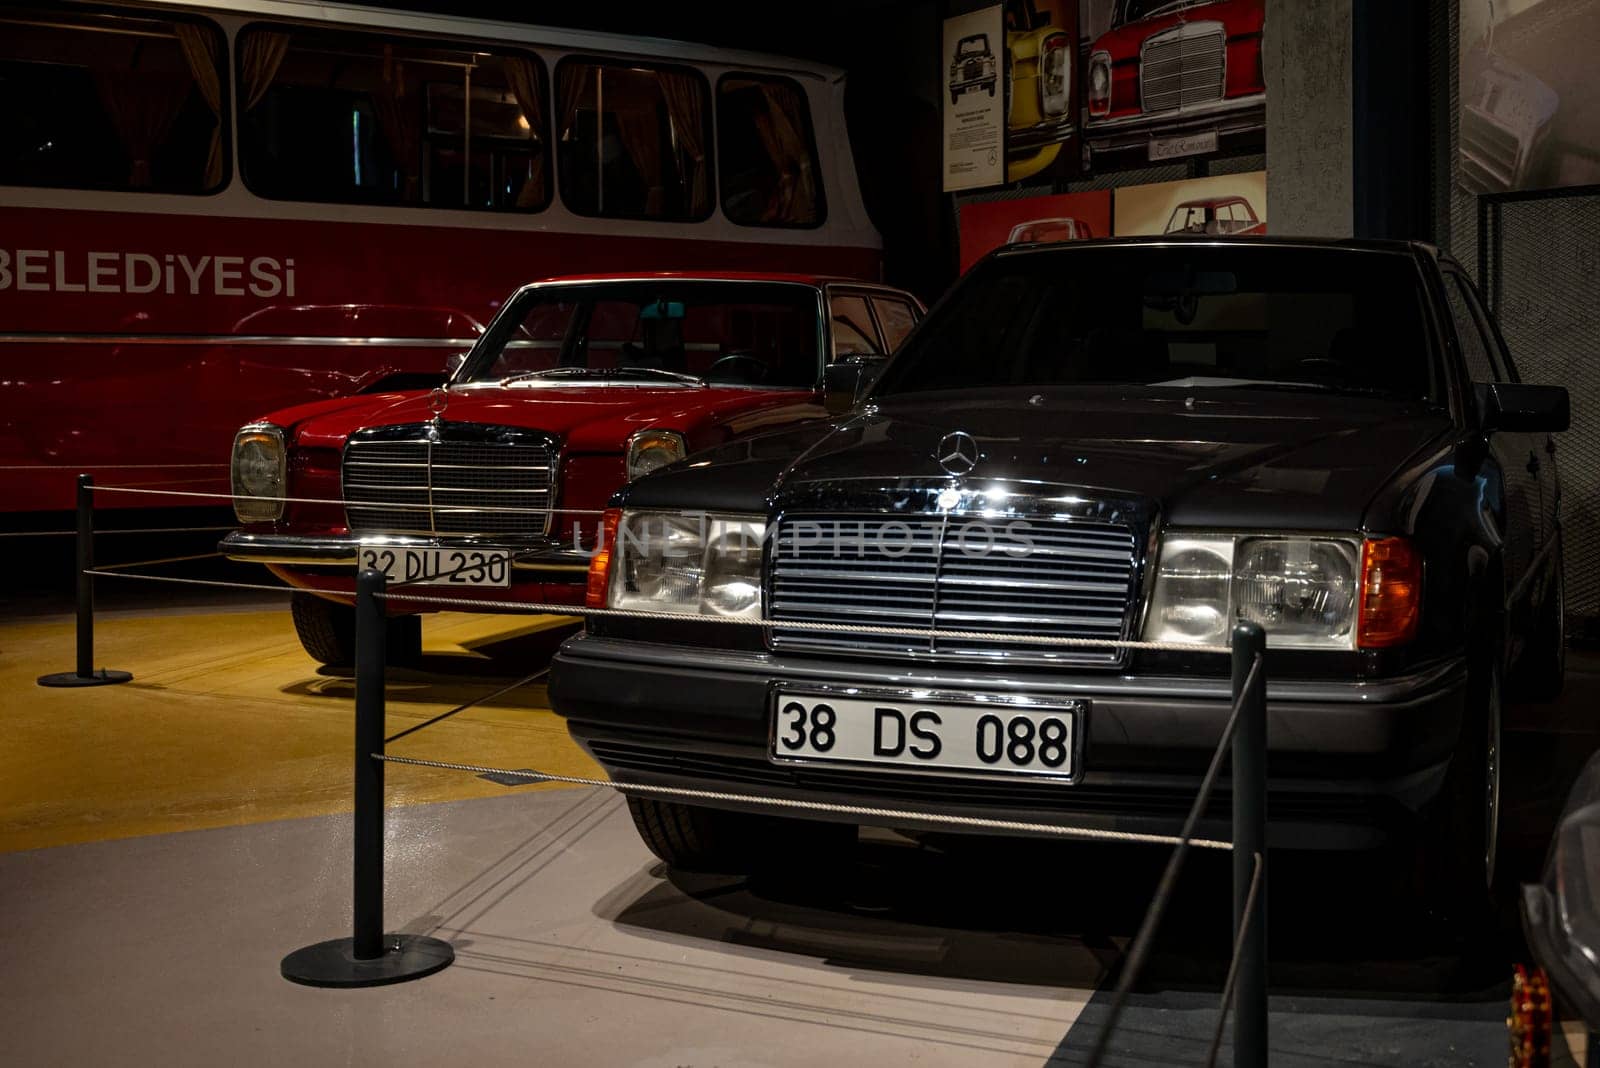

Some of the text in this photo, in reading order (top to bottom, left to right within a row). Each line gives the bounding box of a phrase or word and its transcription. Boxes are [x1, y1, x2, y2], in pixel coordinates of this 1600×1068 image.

[406, 551, 440, 581] DU
[450, 552, 505, 583] 230
[782, 702, 1068, 768] 38 DS 088
